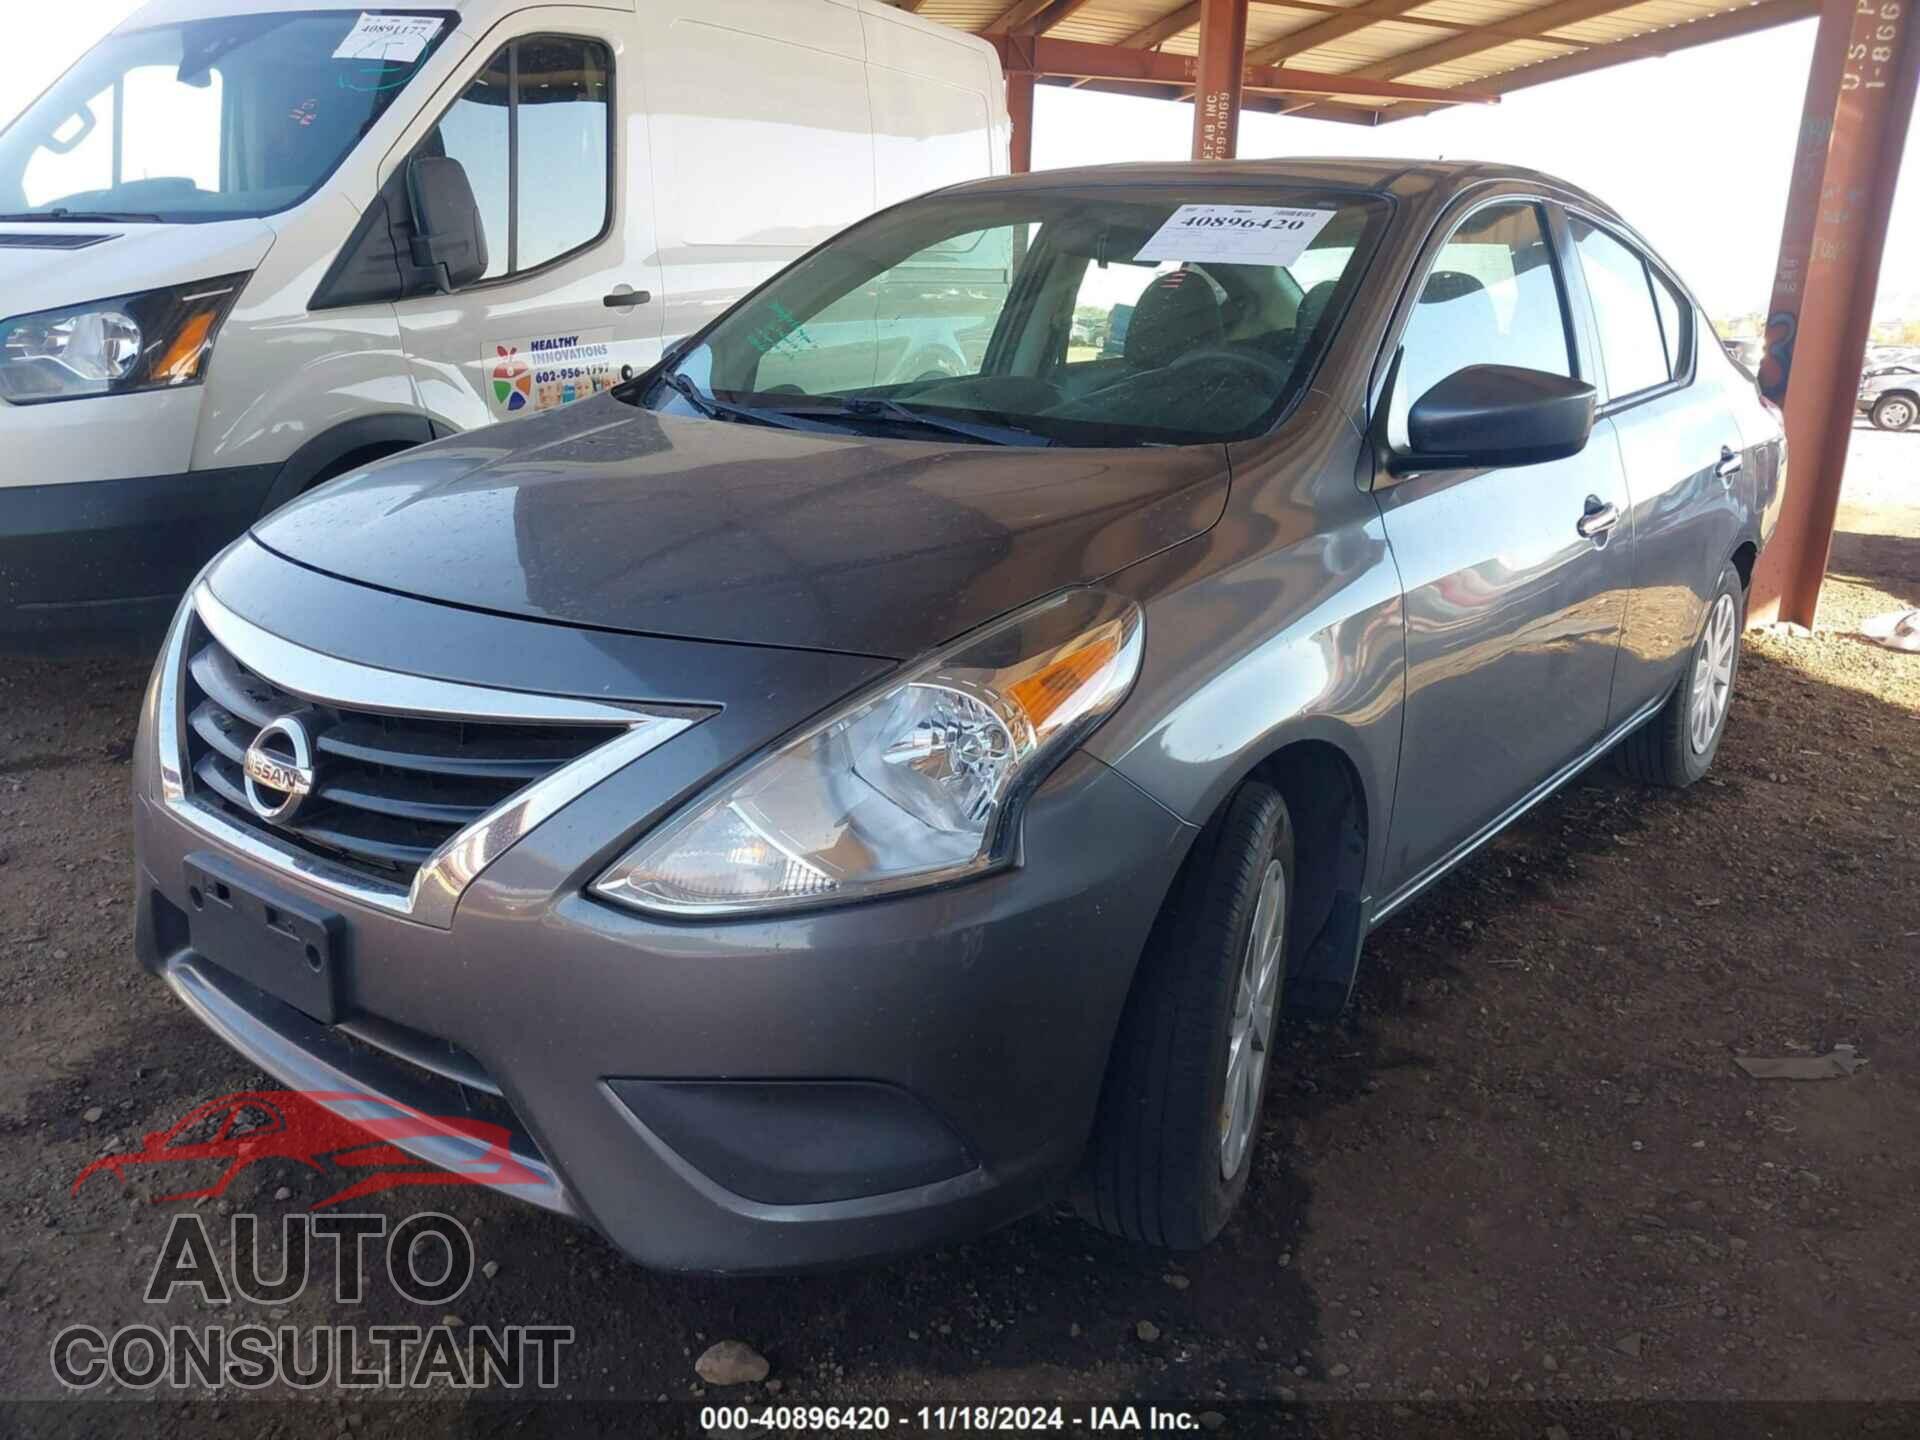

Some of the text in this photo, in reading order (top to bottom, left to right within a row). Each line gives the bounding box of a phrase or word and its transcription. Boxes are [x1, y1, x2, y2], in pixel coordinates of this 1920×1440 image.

[1865, 3, 1901, 88] 1-866
[1841, 34, 1870, 90] U.S.
[1181, 216, 1305, 231] 40896420
[530, 336, 580, 351] HEALTHY
[531, 344, 608, 364] INNOVATIONS
[246, 757, 297, 787] NISSAN
